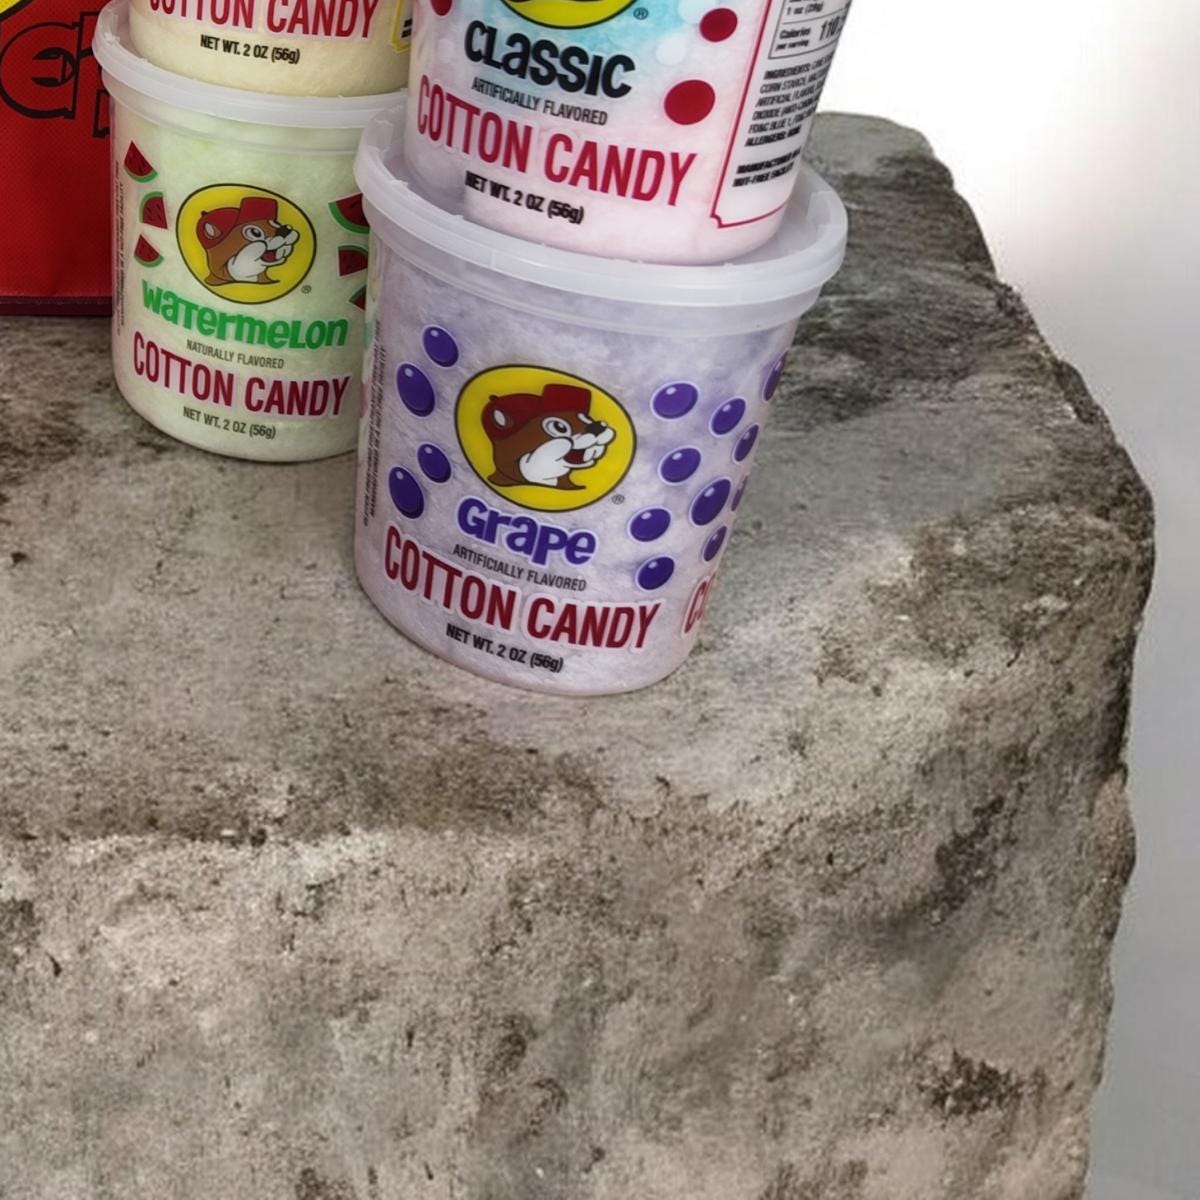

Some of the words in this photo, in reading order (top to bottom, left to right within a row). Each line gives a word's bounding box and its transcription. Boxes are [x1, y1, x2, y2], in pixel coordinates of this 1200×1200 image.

[200, 34, 221, 51] NET
[222, 39, 241, 56] WT.
[243, 43, 251, 57] 2
[253, 45, 269, 59] OZ
[271, 47, 300, 64] (56g)
[471, 76, 541, 111] ARTIFICIALLY
[543, 100, 608, 125] FLAVORED
[417, 75, 532, 173] COTTON
[544, 133, 697, 206] CANDY
[465, 170, 488, 193] NET
[490, 181, 511, 202] WT.
[514, 190, 523, 206] 2
[526, 194, 544, 213] OZ
[547, 199, 584, 224] (56g)
[133, 331, 234, 407] COTTON
[244, 375, 350, 416] CANDY
[186, 339, 235, 363] NATURALLY
[237, 353, 285, 369] FLAVORED
[183, 406, 202, 422] NET
[203, 412, 221, 429] WT.
[223, 419, 230, 429] 2
[232, 422, 247, 434] OZ
[249, 425, 276, 440] (56g)
[384, 525, 516, 630] COTTON
[526, 597, 661, 649] CANDY
[453, 544, 524, 579] ARTIFICIALLY
[526, 571, 587, 592] FLAVORED
[446, 623, 470, 645] NET
[473, 634, 494, 654] WT.
[497, 643, 506, 658] 2
[509, 647, 527, 664] OZ
[530, 651, 564, 673] (56g)
